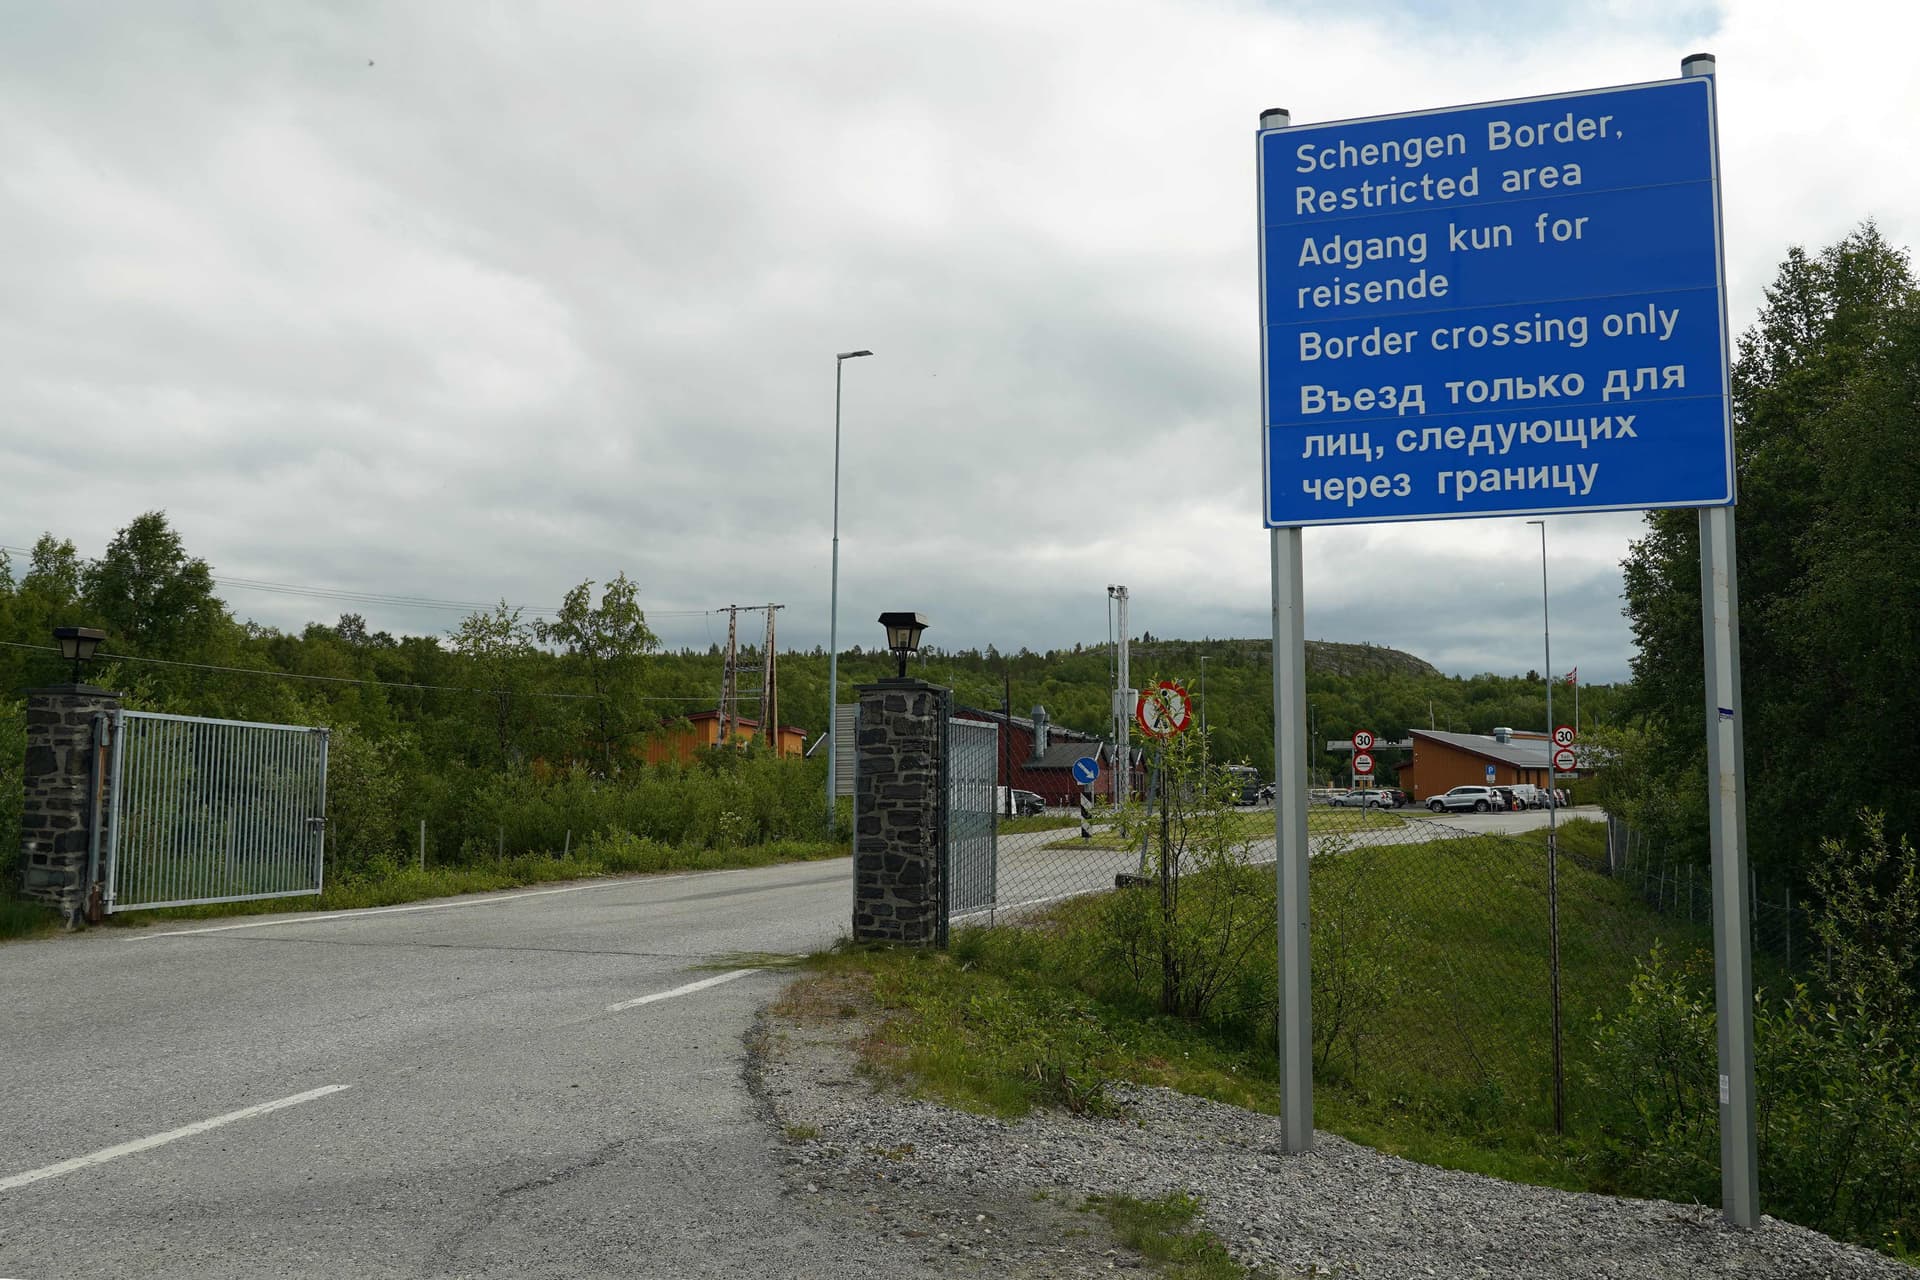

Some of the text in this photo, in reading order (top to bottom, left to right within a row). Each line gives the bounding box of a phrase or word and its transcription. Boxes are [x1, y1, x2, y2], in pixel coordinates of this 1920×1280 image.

[1296, 113, 1623, 174] Schengen Border,
[1296, 163, 1582, 215] Restricted area
[1298, 214, 1589, 270] Adgang kun for
[1298, 270, 1449, 309] reisende
[1300, 304, 1680, 361] Border crossing only
[1301, 365, 1685, 415] Въезд только для
[1302, 416, 1638, 461] лиц, следующих
[1302, 464, 1599, 507] через границу
[1357, 735, 1370, 746] 30
[1557, 731, 1572, 742] 30
